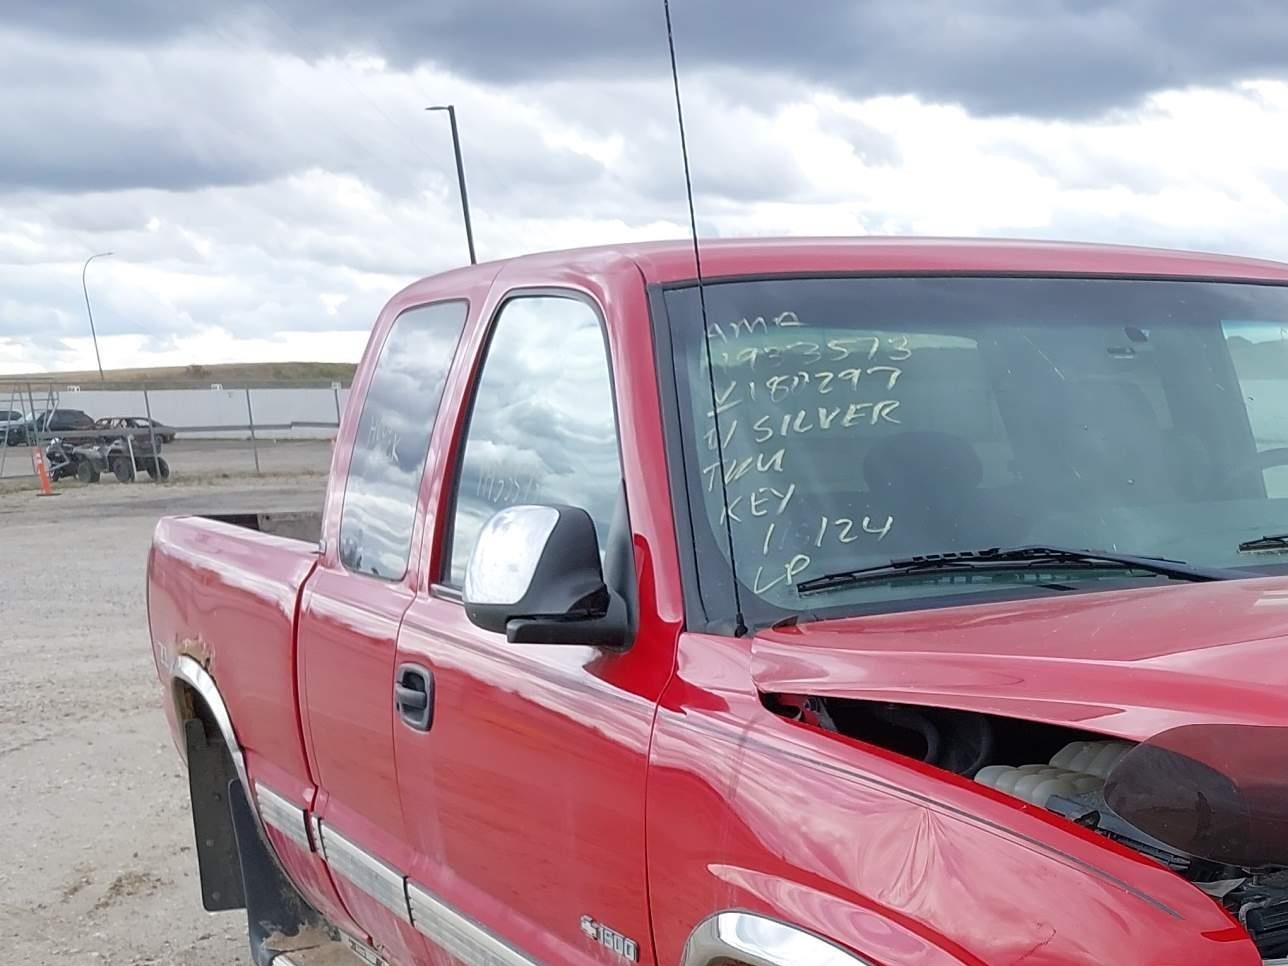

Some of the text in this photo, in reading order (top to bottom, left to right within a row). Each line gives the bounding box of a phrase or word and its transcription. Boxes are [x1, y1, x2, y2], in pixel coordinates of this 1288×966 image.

[752, 400, 903, 443] SILVER
[719, 483, 796, 525] KEY
[814, 515, 894, 548] 124
